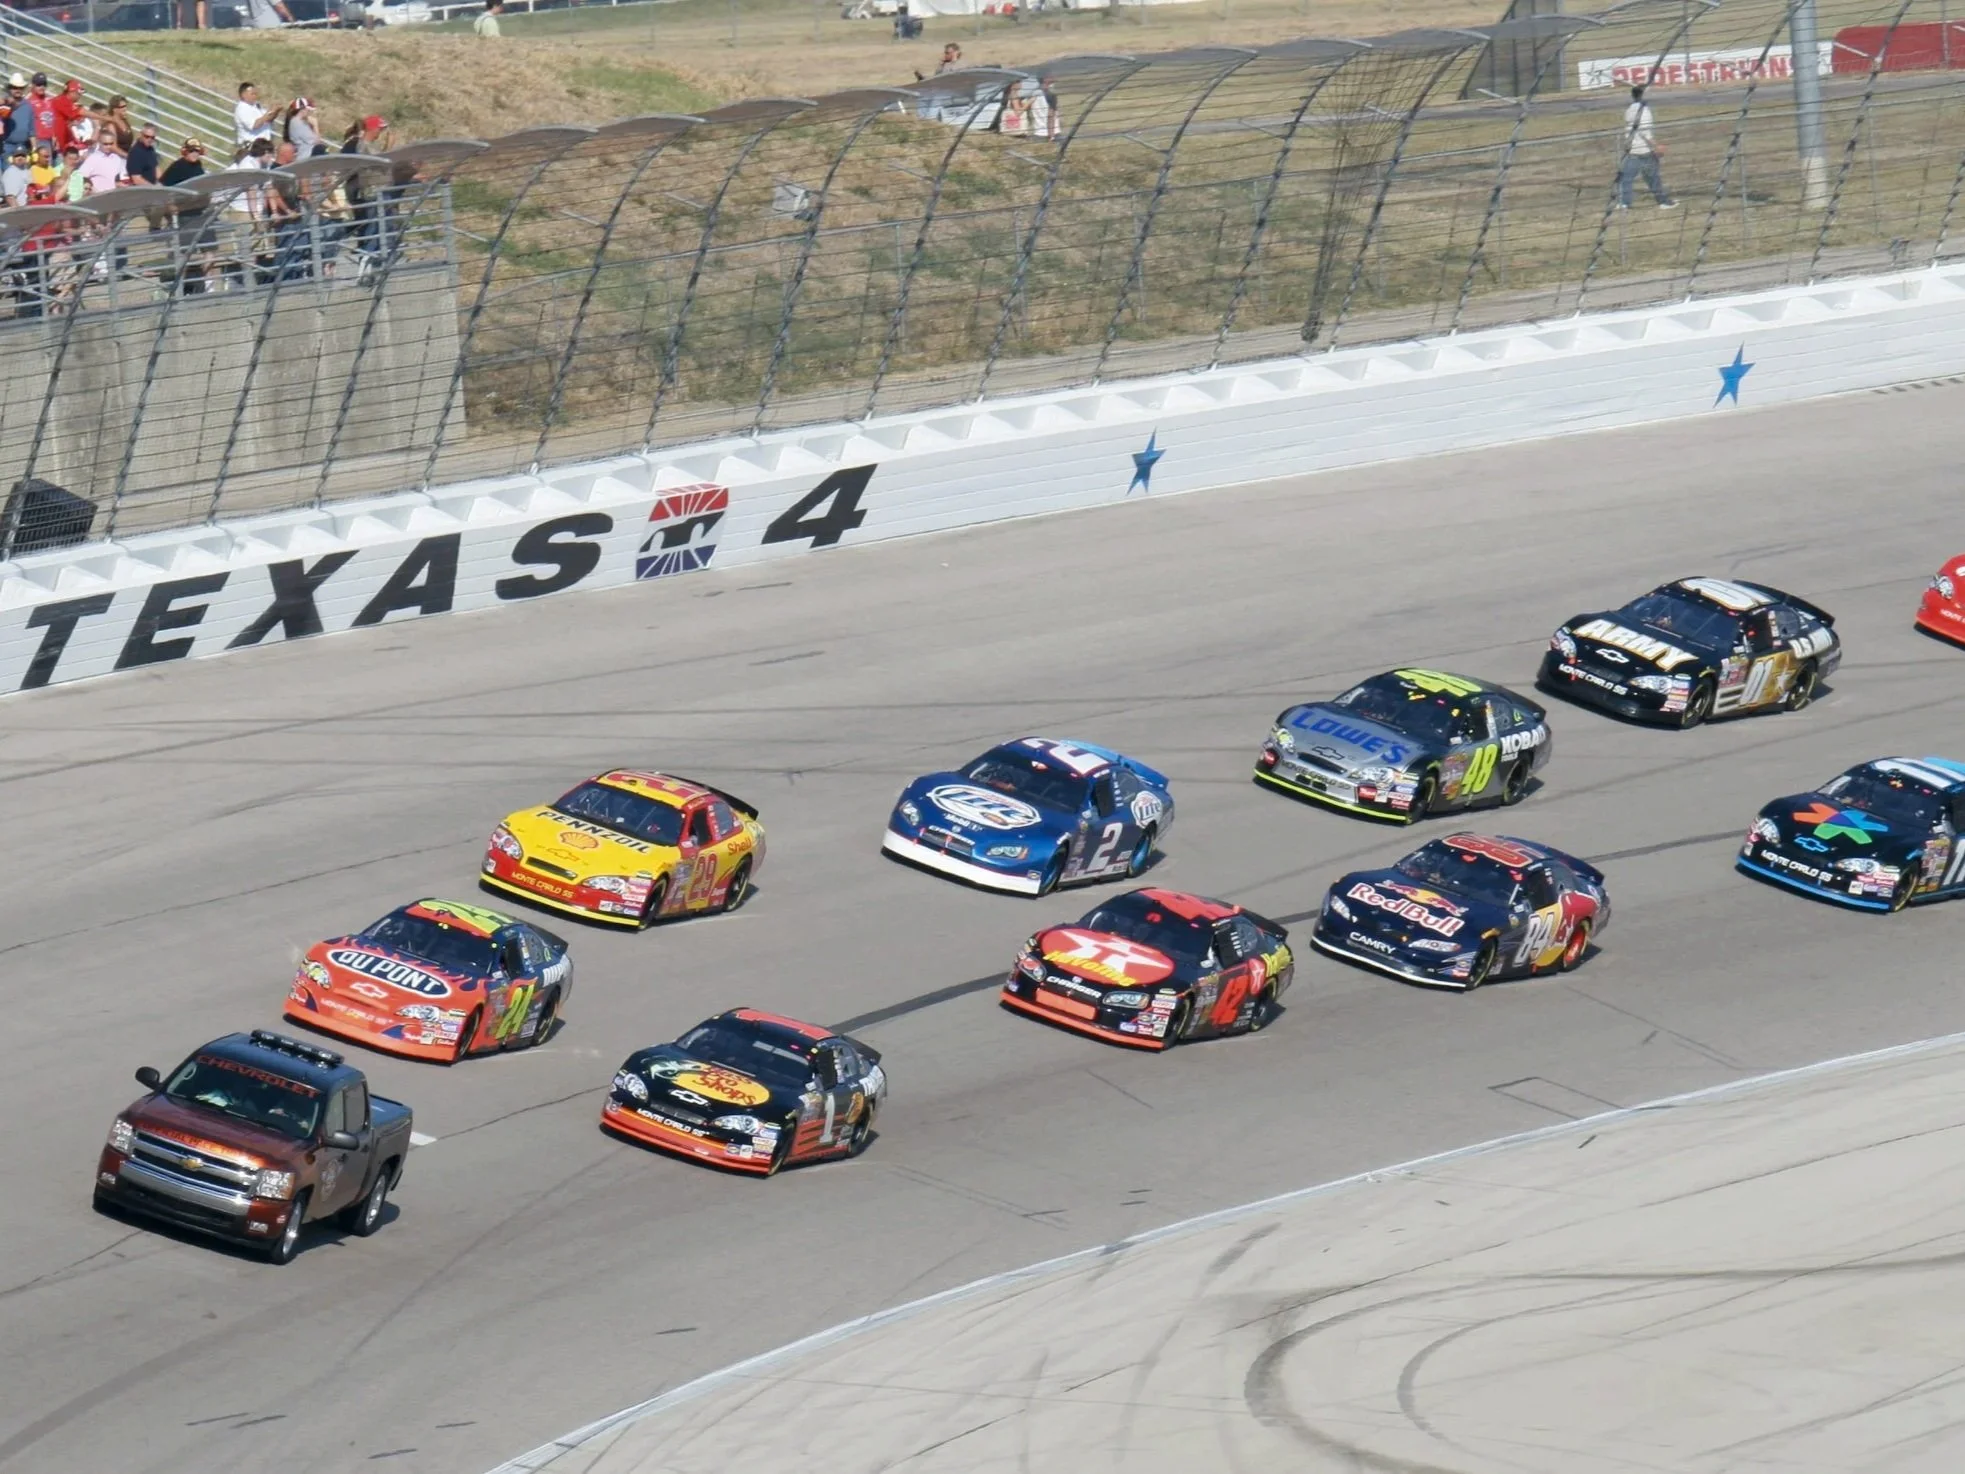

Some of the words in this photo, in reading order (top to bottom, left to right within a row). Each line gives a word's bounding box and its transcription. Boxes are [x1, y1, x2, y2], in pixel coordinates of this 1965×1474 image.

[20, 512, 613, 690] TEXAS
[761, 463, 879, 549] 4
[1572, 619, 1699, 672] ARMY
[1461, 743, 1498, 797] 48
[536, 810, 650, 854] PENNZOIL
[727, 837, 752, 856] Shell
[1087, 822, 1123, 873] 2
[511, 871, 535, 885] MONTE
[1347, 883, 1409, 913] Red
[1400, 903, 1465, 937] Bull
[1350, 932, 1396, 955] CAMRY
[1512, 911, 1555, 967] 84
[338, 951, 375, 969] DU
[370, 959, 441, 992] PONT
[197, 1055, 320, 1099] CHEVROLET
[692, 1078, 758, 1106] Shops
[819, 1092, 835, 1143] 1
